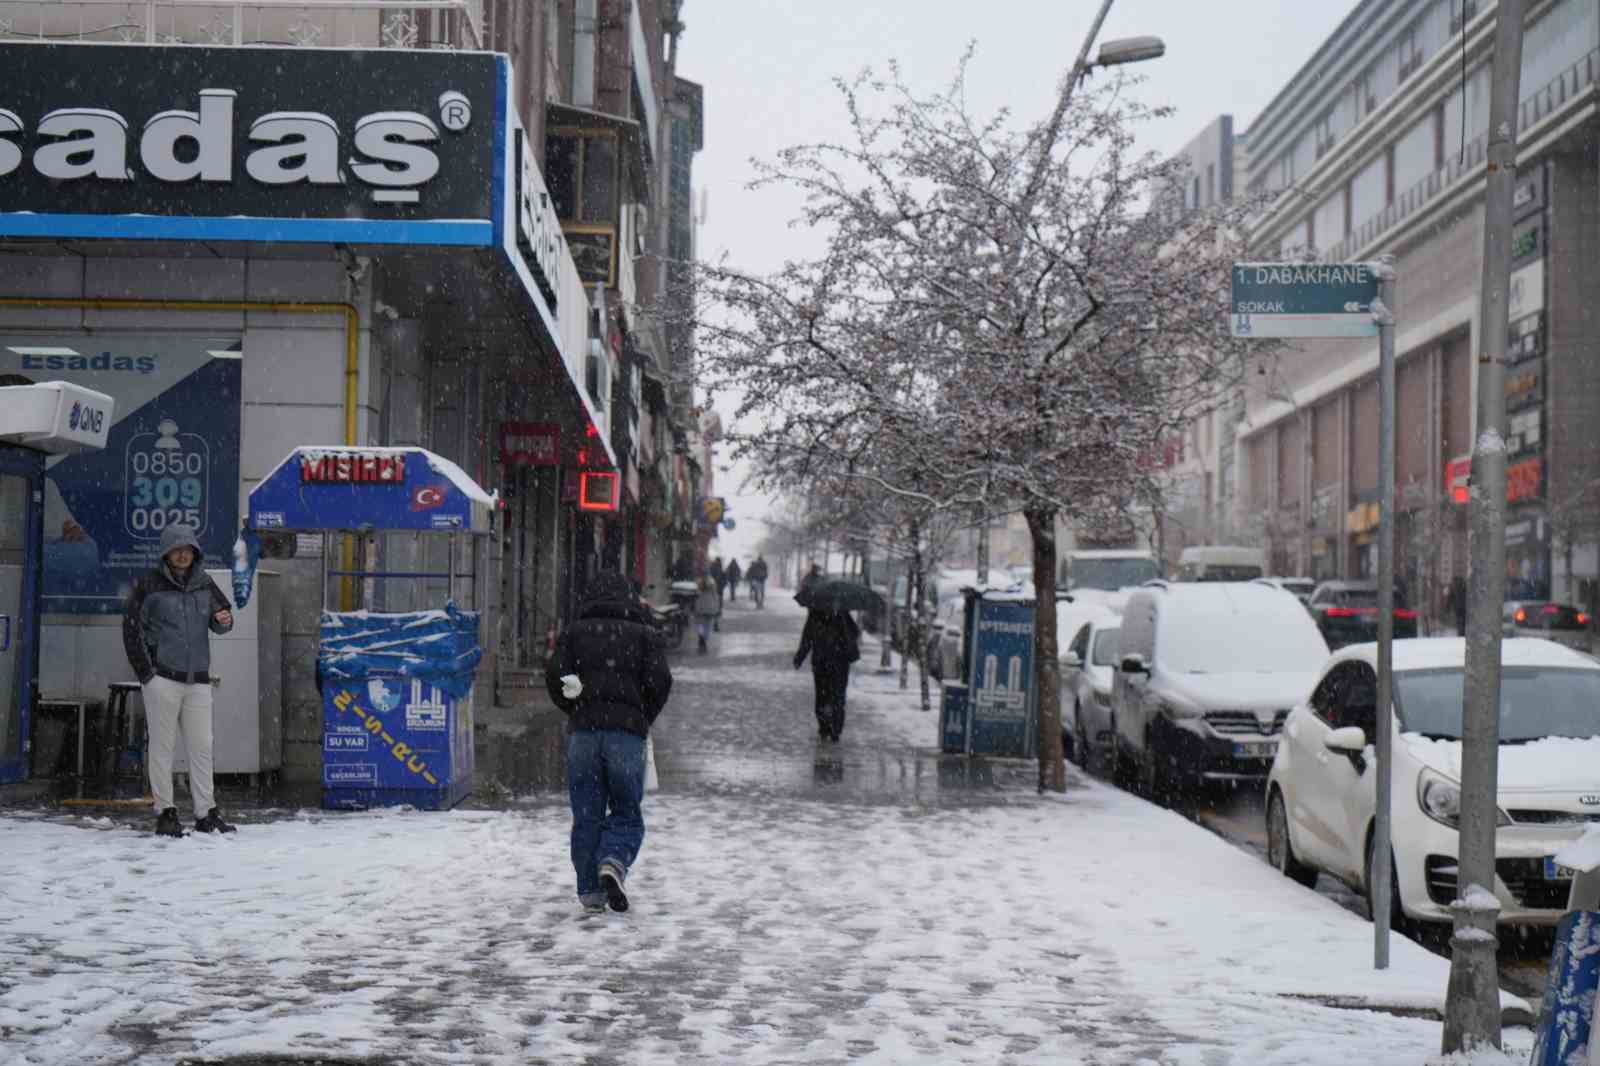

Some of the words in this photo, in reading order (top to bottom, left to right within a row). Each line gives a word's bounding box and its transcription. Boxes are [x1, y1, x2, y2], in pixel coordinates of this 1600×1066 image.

[1237, 269, 1251, 284] 1.
[1256, 267, 1368, 285] DABAKHANE
[1237, 302, 1285, 312] SOKAK
[21, 352, 155, 374] Esadaş
[80, 406, 104, 433] QNB
[133, 451, 202, 474] 0850
[131, 477, 202, 508] 309
[132, 508, 201, 531] 0025
[328, 737, 342, 747] SU
[344, 737, 365, 747] VAR
